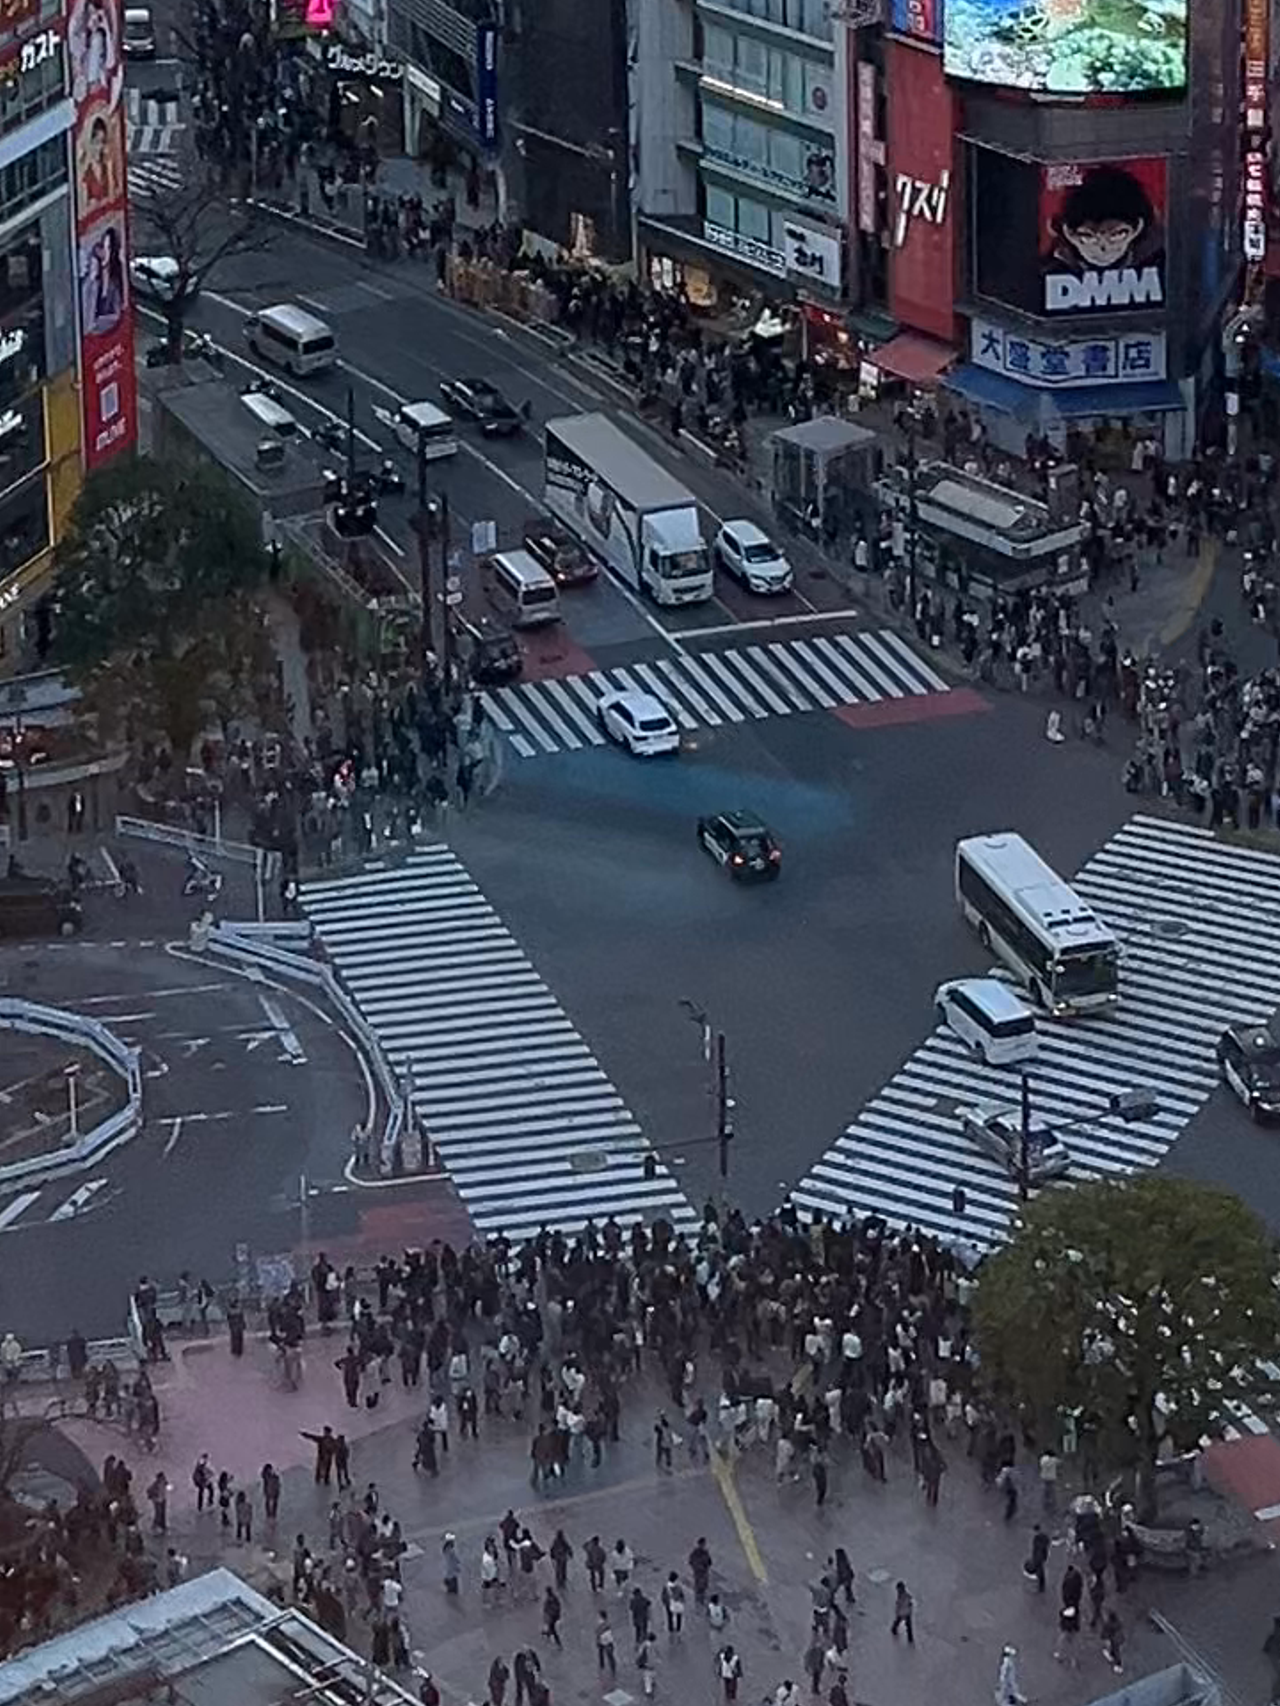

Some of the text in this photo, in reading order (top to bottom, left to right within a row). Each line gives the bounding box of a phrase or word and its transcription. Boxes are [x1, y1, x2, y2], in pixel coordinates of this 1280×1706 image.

[20, 28, 61, 74] ガスト
[1044, 265, 1164, 311] DMM
